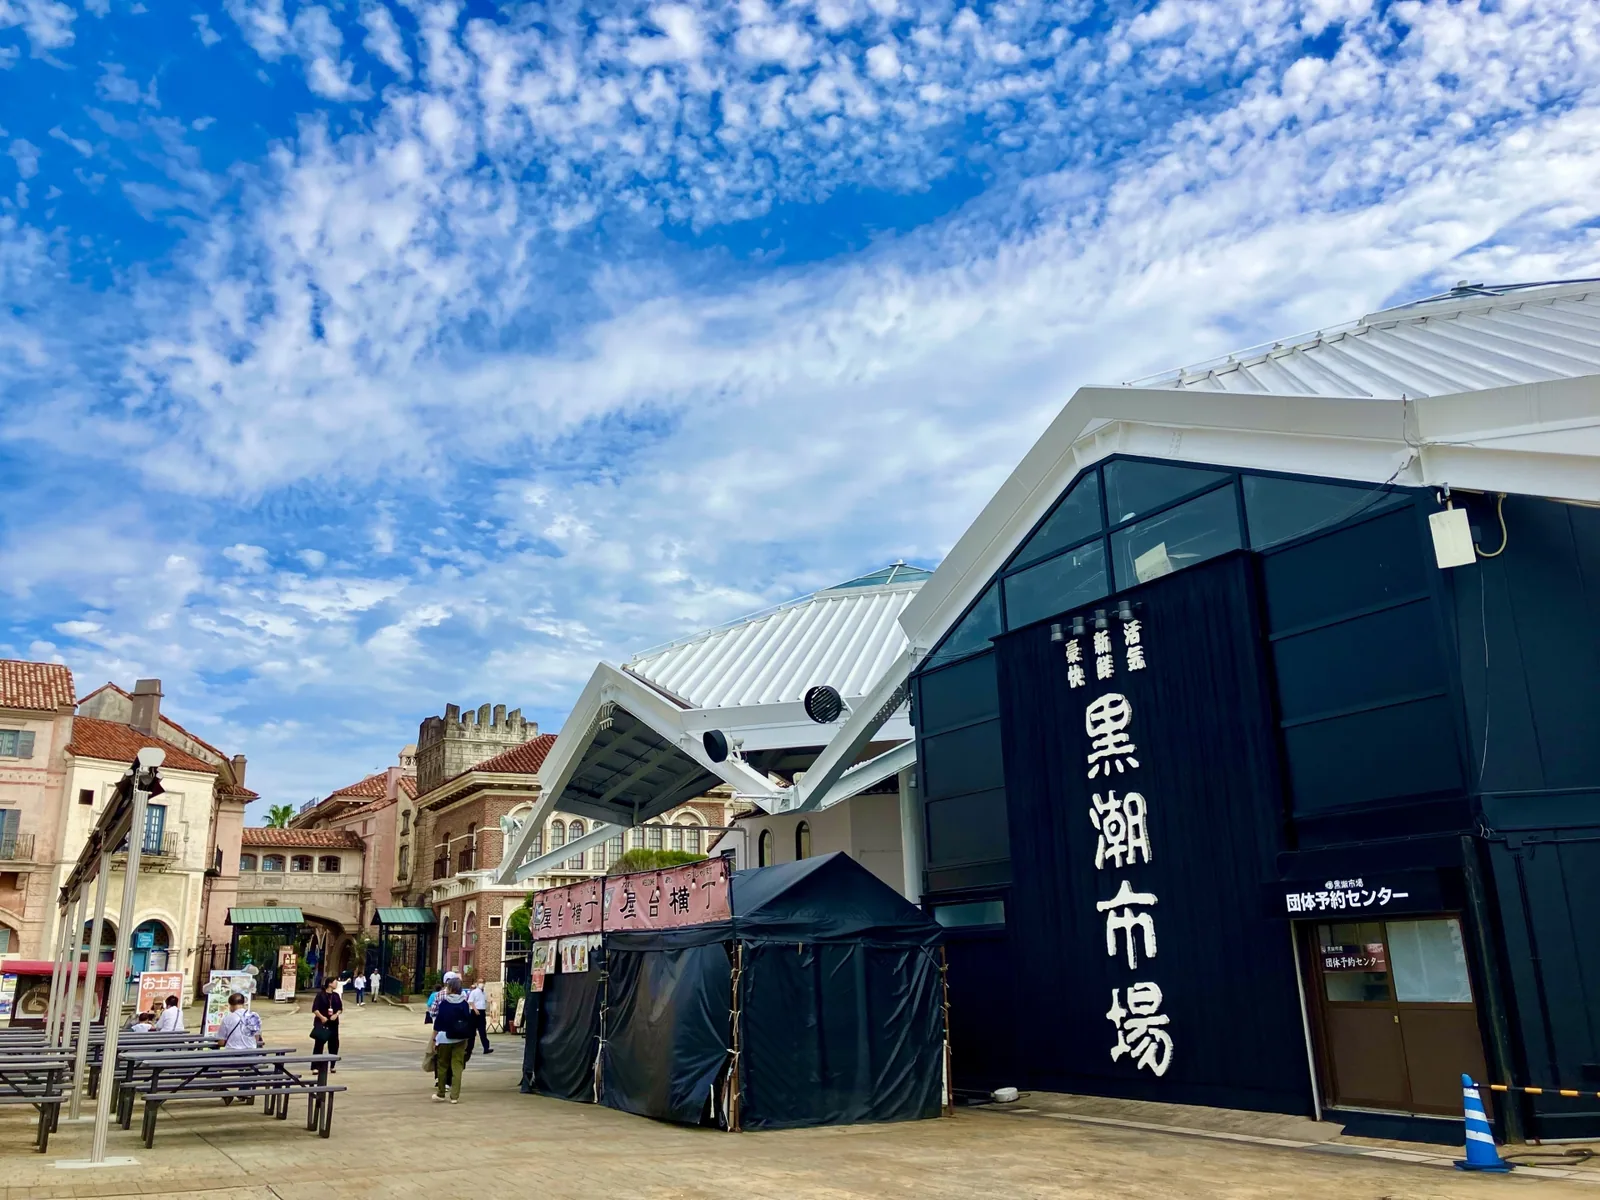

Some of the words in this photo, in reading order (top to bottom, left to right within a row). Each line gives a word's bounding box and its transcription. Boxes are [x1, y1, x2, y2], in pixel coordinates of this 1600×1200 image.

[1064, 638, 1087, 689] 豪快
[1093, 629, 1115, 681] 新鮮
[1123, 619, 1147, 672] 活気
[620, 880, 716, 920] 屋台横丁
[1085, 692, 1175, 1078] 黒潮市場
[1286, 886, 1409, 912] 団体予約センター
[142, 976, 181, 990] お土産
[1325, 957, 1385, 968] 団体予約センター
